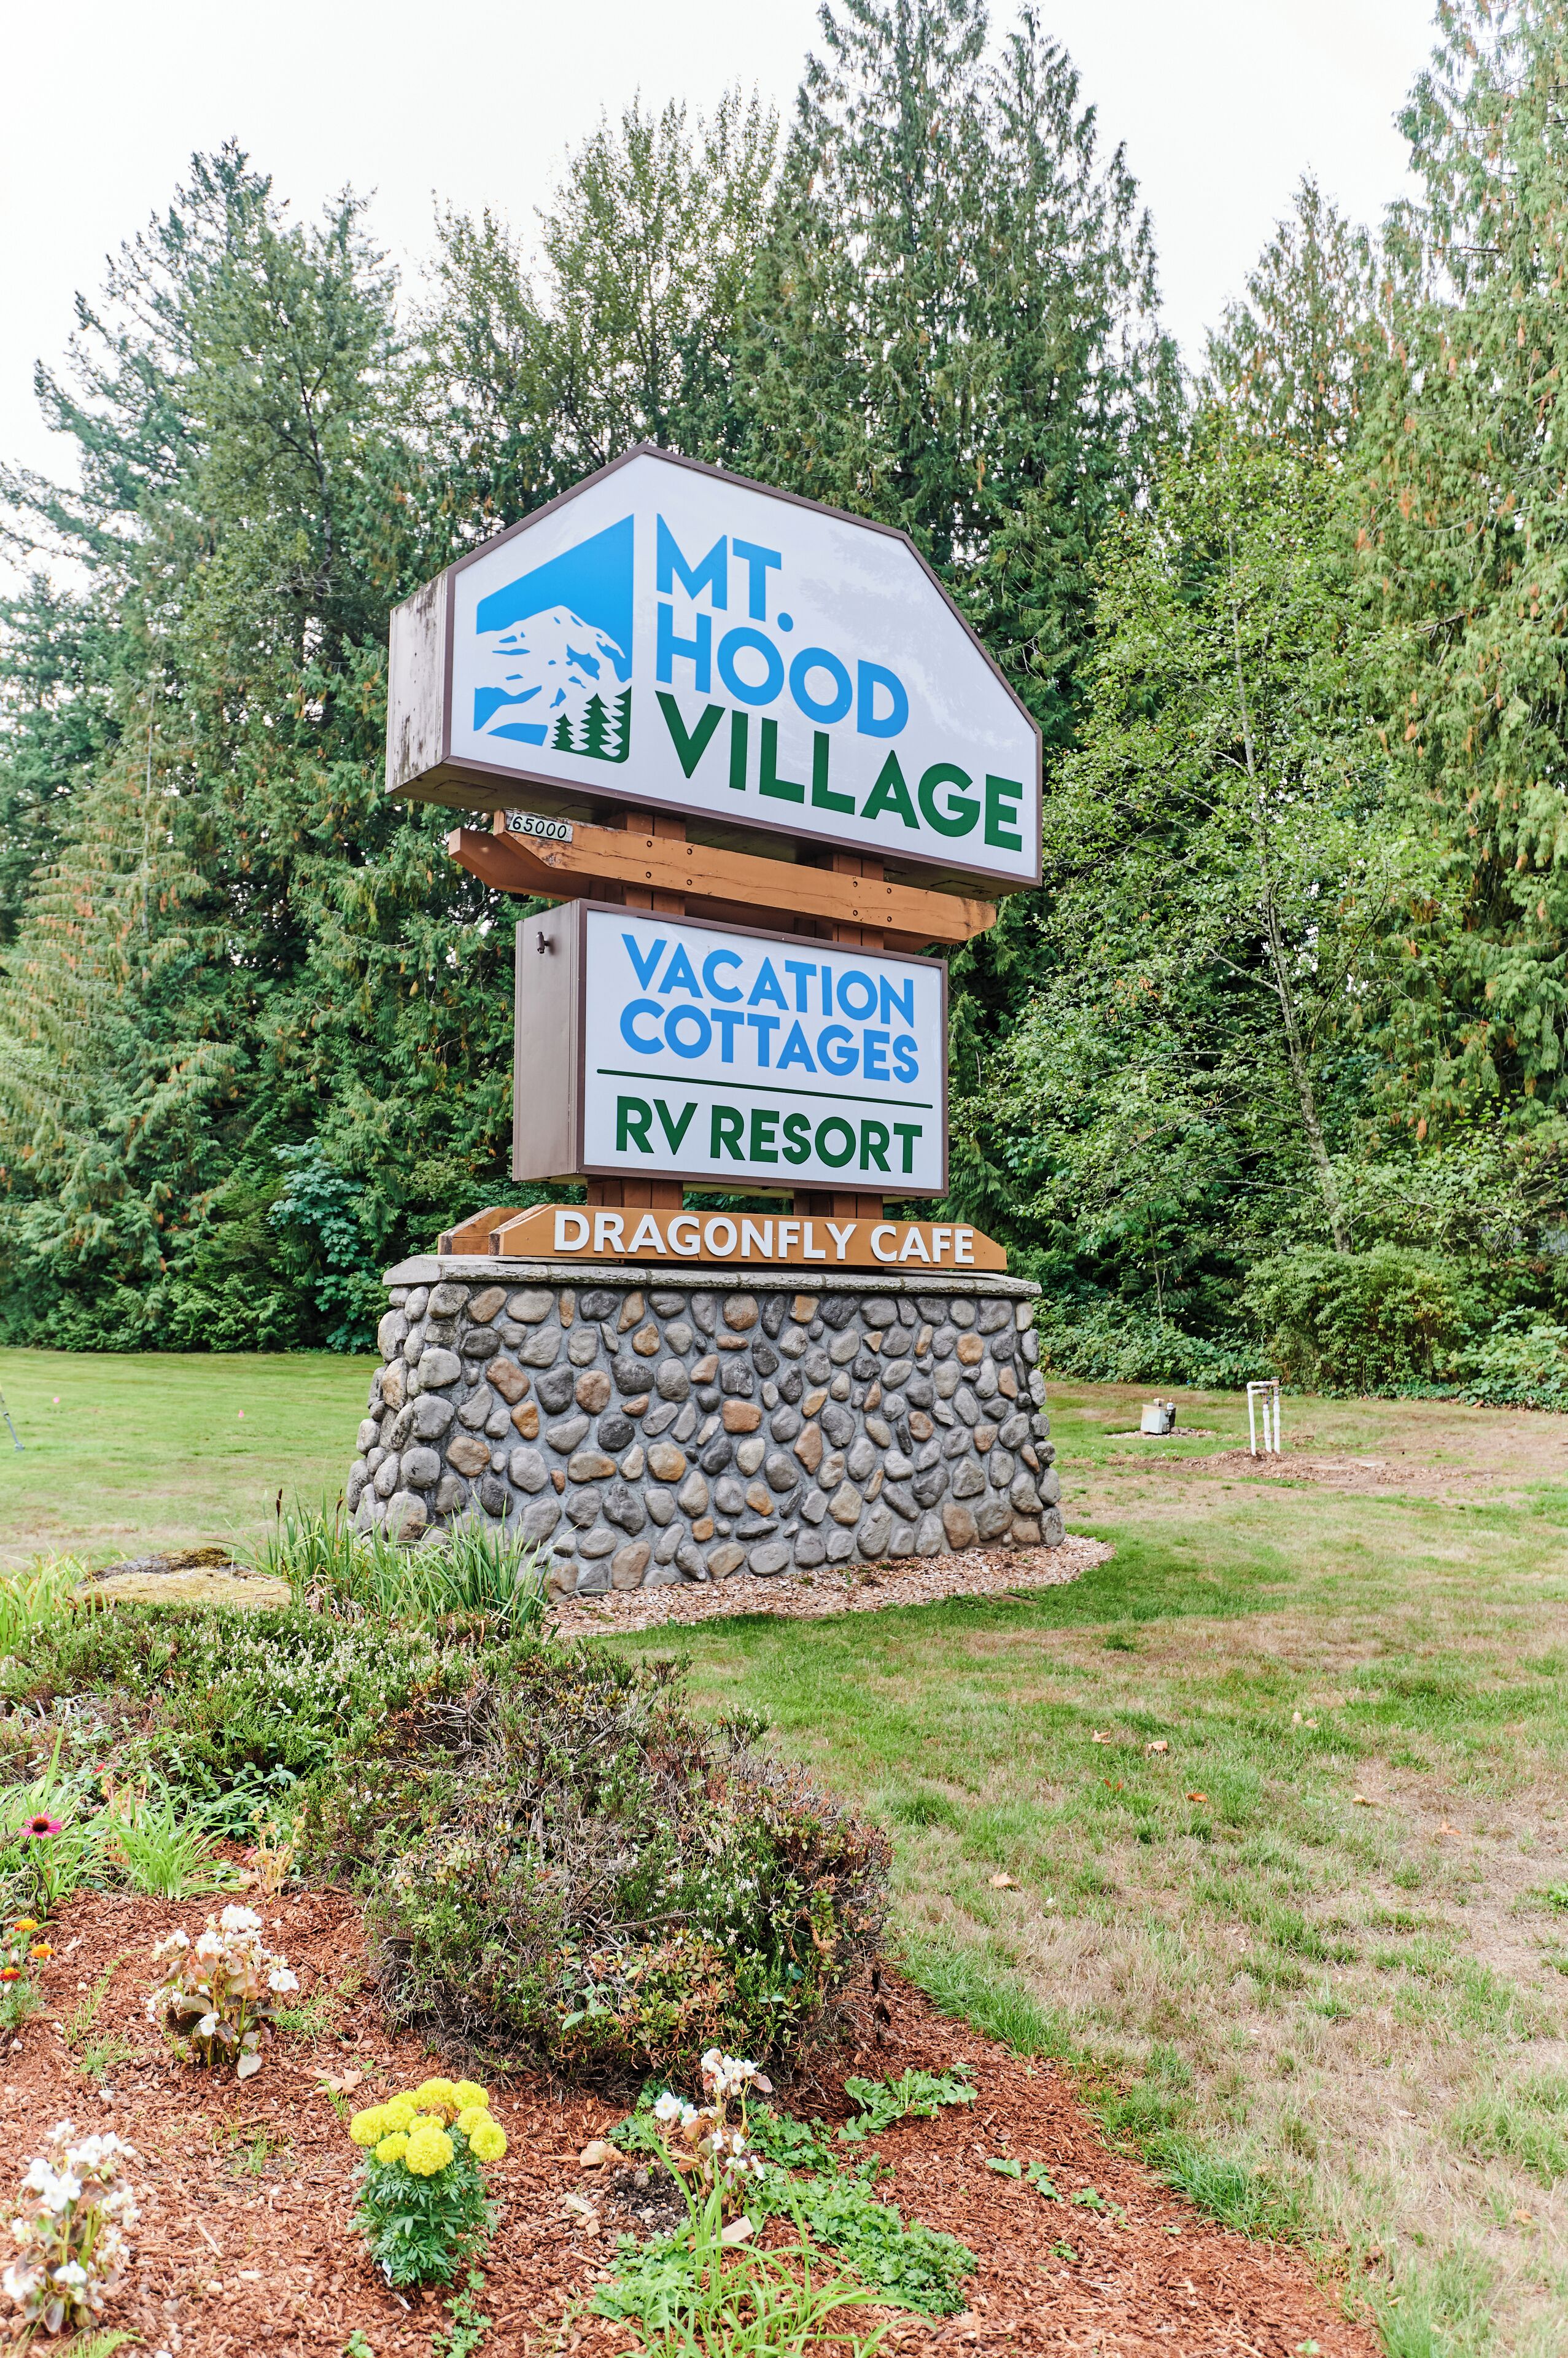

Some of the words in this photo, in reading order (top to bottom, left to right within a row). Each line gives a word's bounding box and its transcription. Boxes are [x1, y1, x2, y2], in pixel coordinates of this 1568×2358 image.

[656, 513, 793, 632] MT.
[656, 602, 909, 738] HOOD
[655, 690, 1023, 852] VILLAGE
[512, 815, 567, 839] 65000
[621, 933, 914, 1028] VACATION
[619, 998, 919, 1083] COTTAGES
[616, 1095, 697, 1156] RV
[710, 1105, 922, 1173] RESORT
[553, 1210, 858, 1260] DRAGONFLY
[871, 1225, 975, 1264] CAFE
